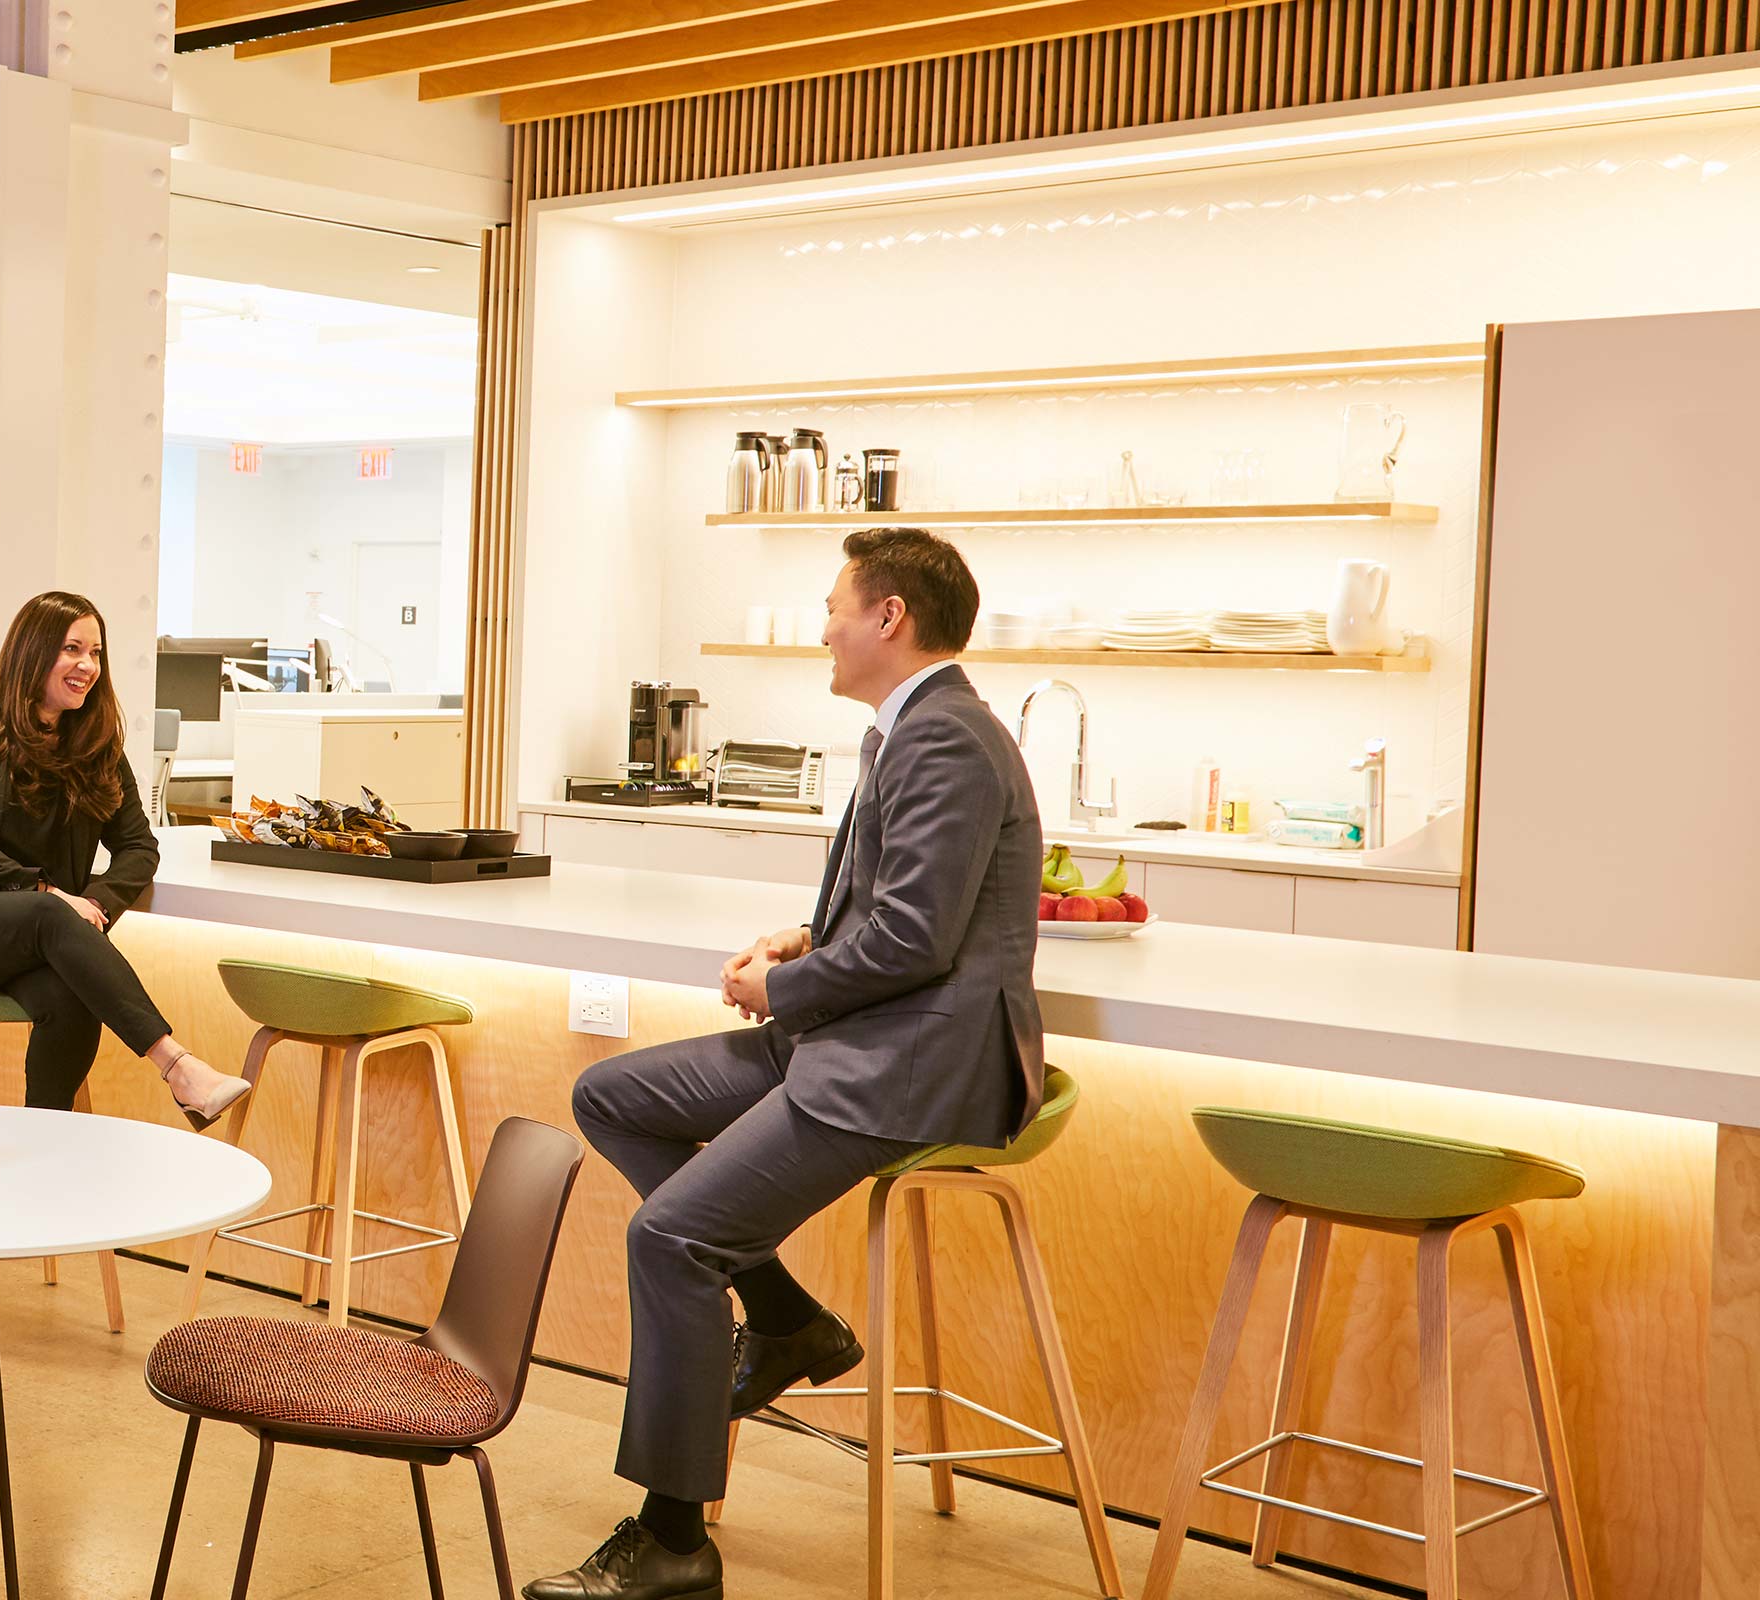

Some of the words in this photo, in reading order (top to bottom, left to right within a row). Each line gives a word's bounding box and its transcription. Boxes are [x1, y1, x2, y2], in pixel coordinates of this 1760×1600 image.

[235, 447, 257, 473] EXIT
[361, 450, 387, 477] EXIT
[404, 610, 413, 622] B
